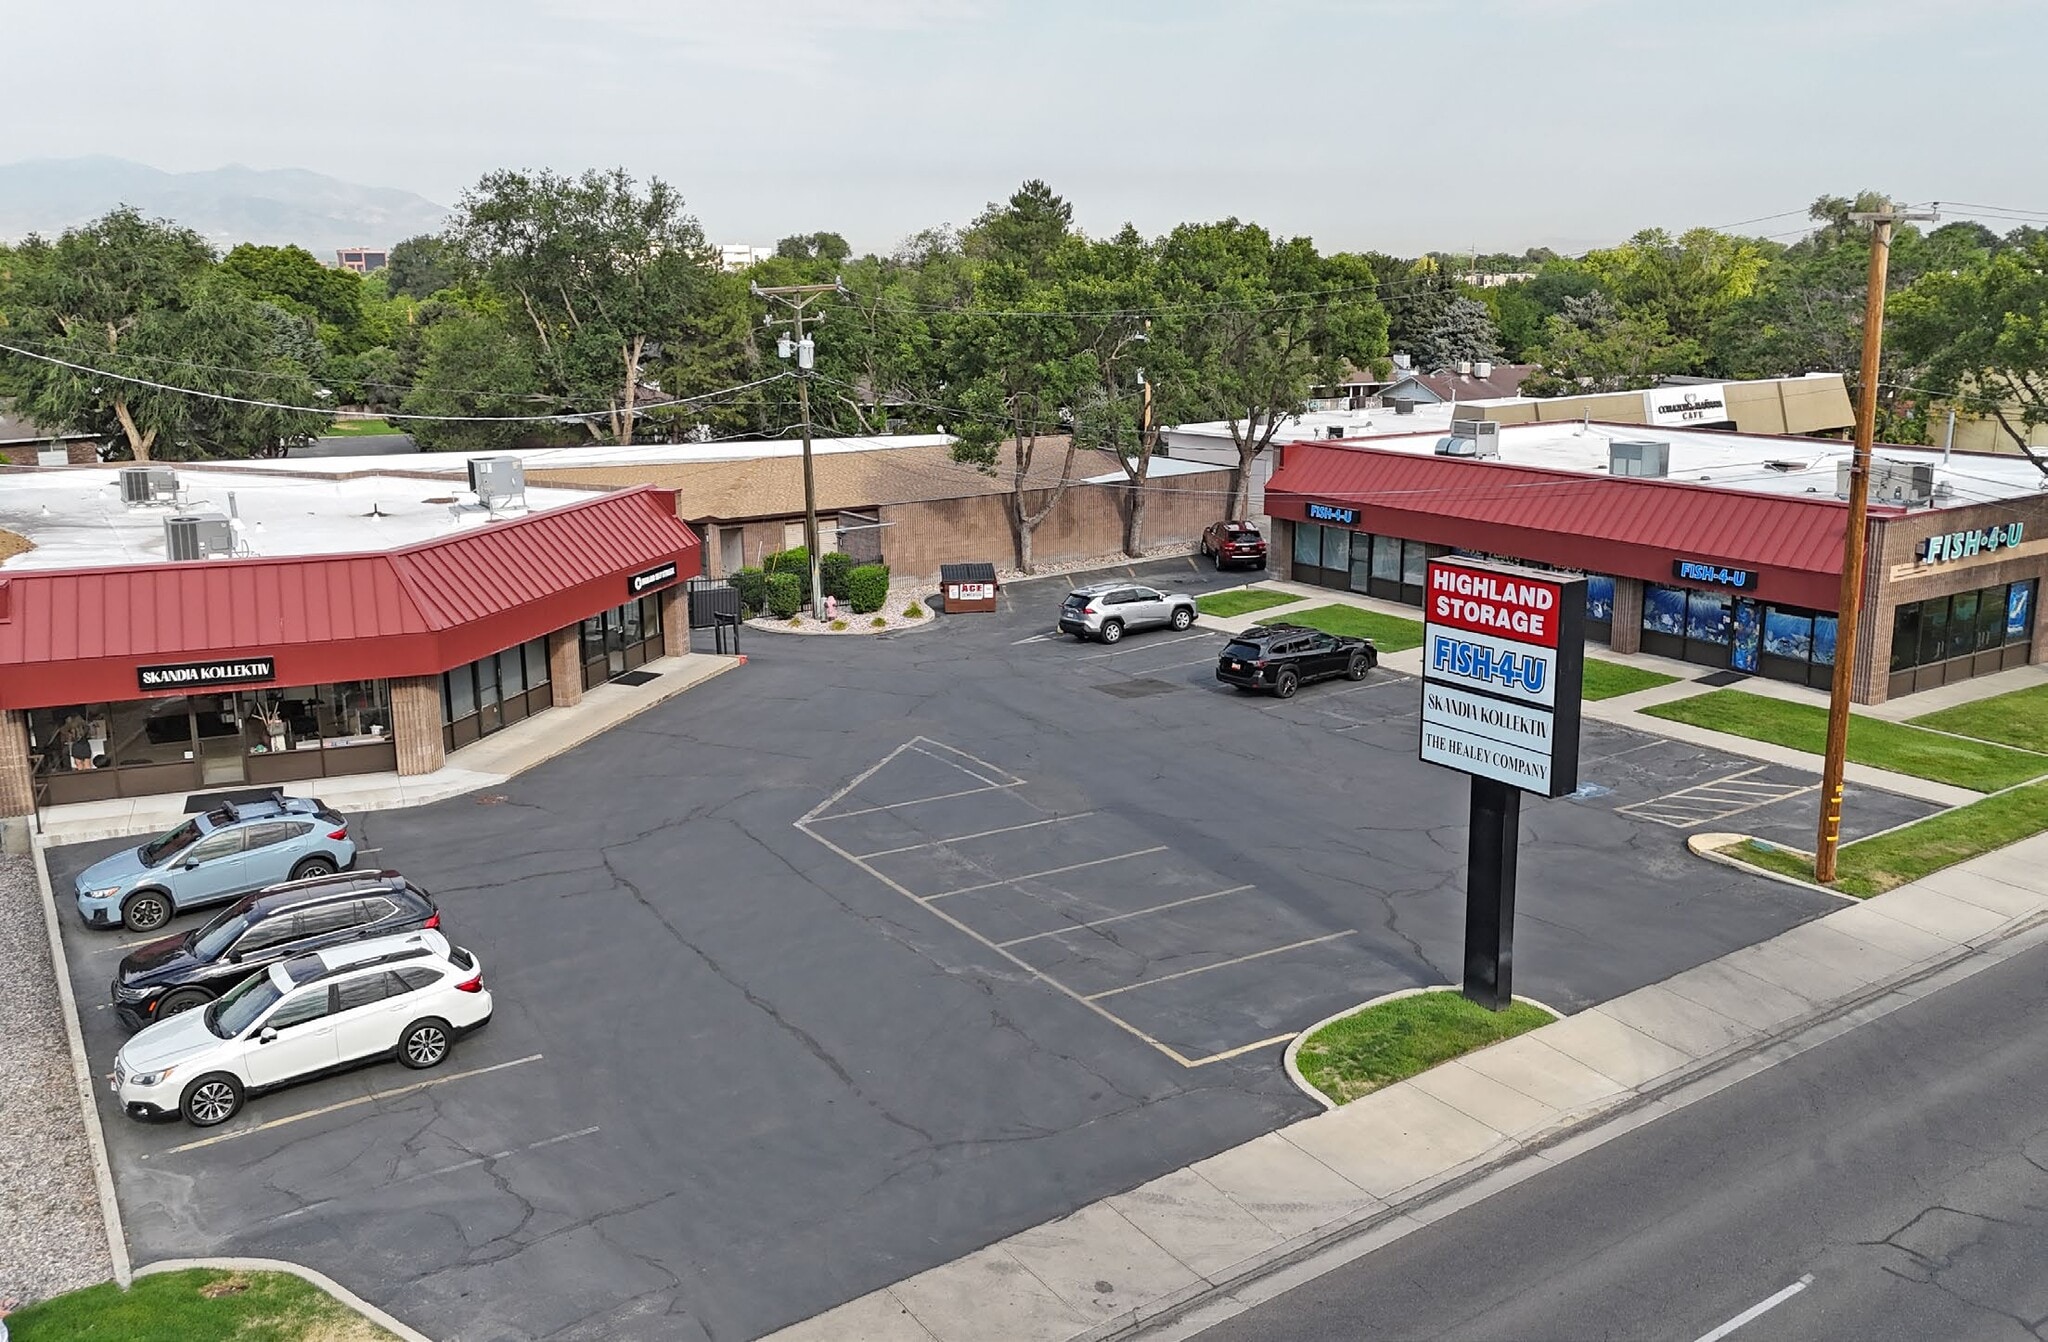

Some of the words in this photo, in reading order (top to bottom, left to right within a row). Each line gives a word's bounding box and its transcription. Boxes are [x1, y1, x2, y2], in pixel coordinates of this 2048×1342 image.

[1310, 504, 1353, 523] FISH-4-U
[1433, 569, 1553, 610] HIGHLAND
[1680, 562, 1746, 587] FISH-4-U
[1436, 595, 1545, 636] STORAGE
[143, 667, 199, 684] SKANDIA
[200, 663, 270, 680] KOLLEKTIV
[1433, 635, 1547, 694] FISH-4-U
[1428, 693, 1477, 721] SKANDIA
[1480, 706, 1549, 739] KOLLEKTIV
[1425, 732, 1447, 751] THE
[1448, 739, 1491, 763] HEALEY
[1492, 751, 1548, 780] COMPANY
